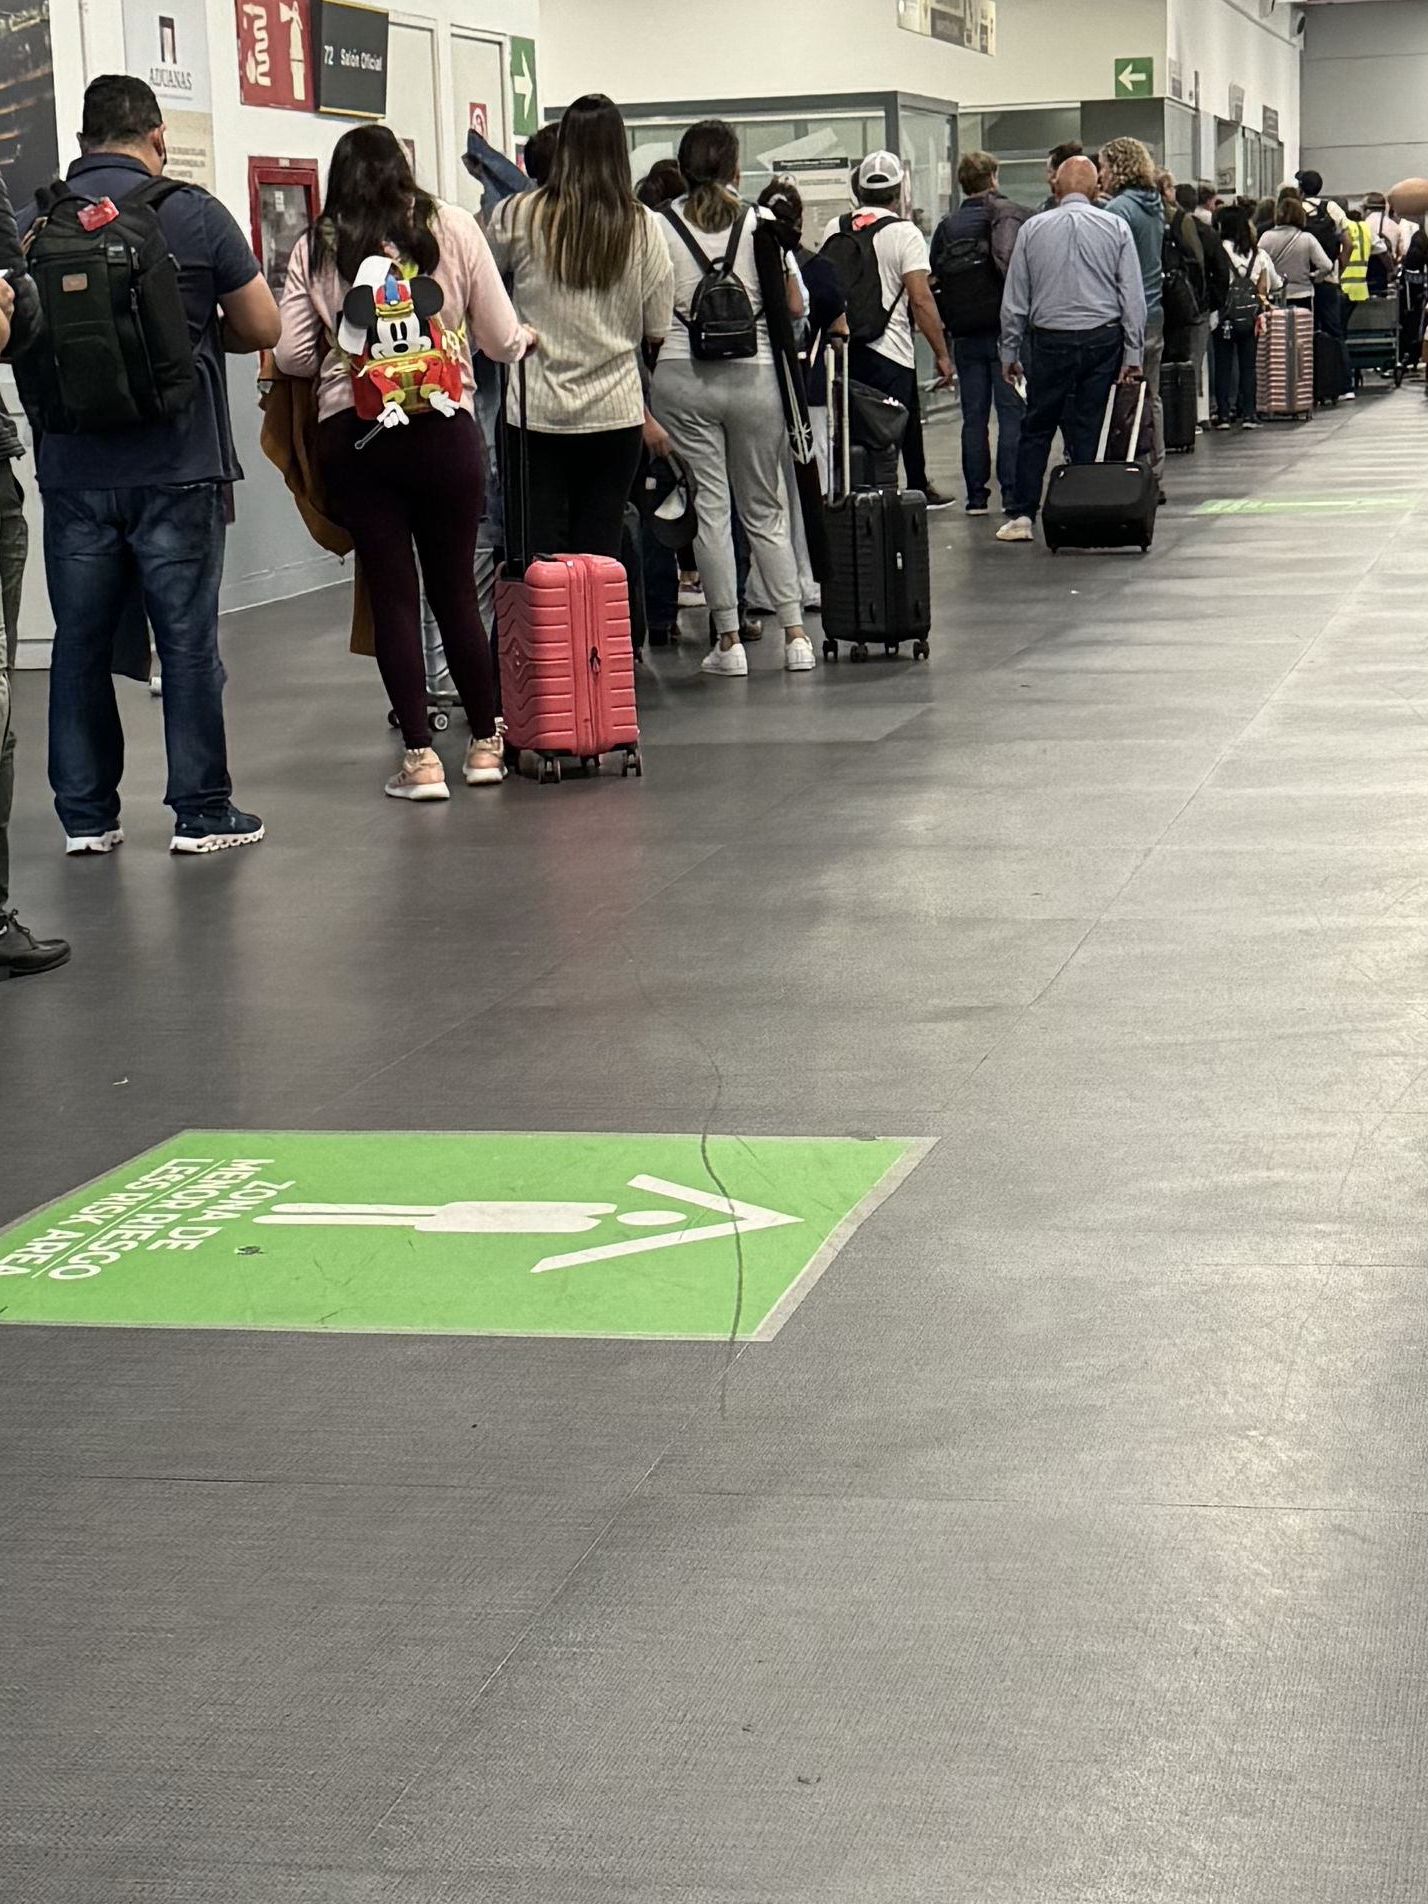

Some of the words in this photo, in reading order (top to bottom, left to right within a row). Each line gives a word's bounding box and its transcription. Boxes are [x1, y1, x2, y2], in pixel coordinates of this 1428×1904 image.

[324, 45, 334, 65] 72
[149, 68, 192, 91] ADUANAS
[124, 1158, 213, 1190] LESS
[158, 1159, 275, 1209] MENOR
[58, 1192, 153, 1225] RISK
[187, 1180, 296, 1222] ZONA
[48, 1213, 182, 1280] RIESGO
[146, 1226, 223, 1250] DE
